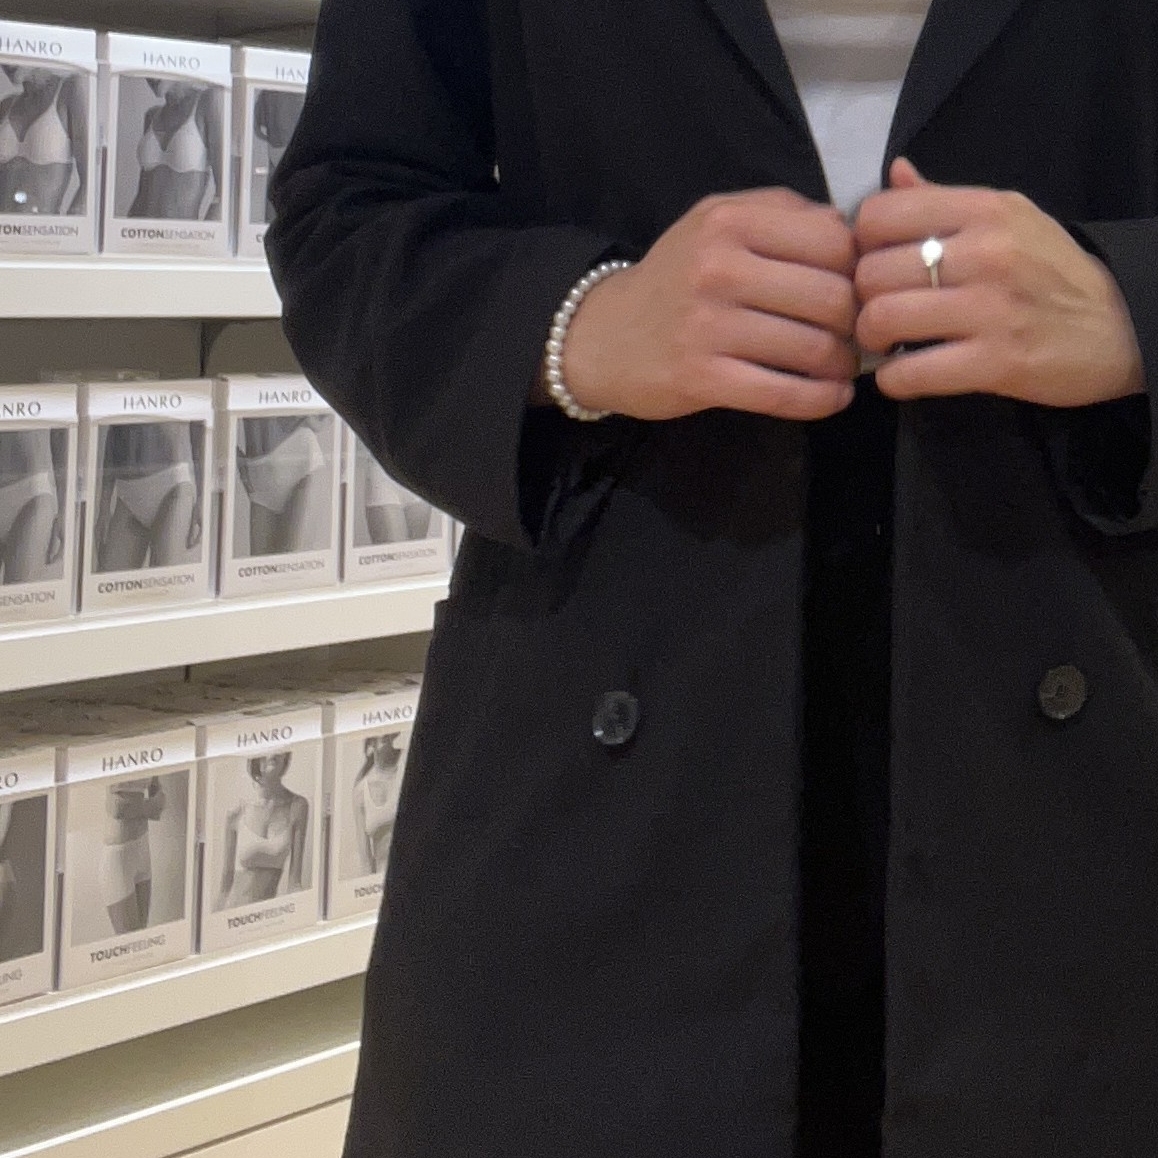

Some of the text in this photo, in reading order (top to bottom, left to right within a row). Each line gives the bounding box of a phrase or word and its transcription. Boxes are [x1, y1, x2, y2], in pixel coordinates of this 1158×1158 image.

[0, 36, 63, 57] HANRO
[143, 51, 201, 70] HANRO
[275, 65, 306, 81] HAN
[121, 228, 215, 241] COTTONSENSATION
[122, 394, 182, 411] HANRO
[258, 389, 312, 405] HANRO
[2, 401, 42, 418] NRO
[97, 573, 195, 594] COTTONSENSATION
[362, 704, 413, 726] HANRO
[236, 725, 293, 748] HANRO
[101, 747, 164, 772] HANRO
